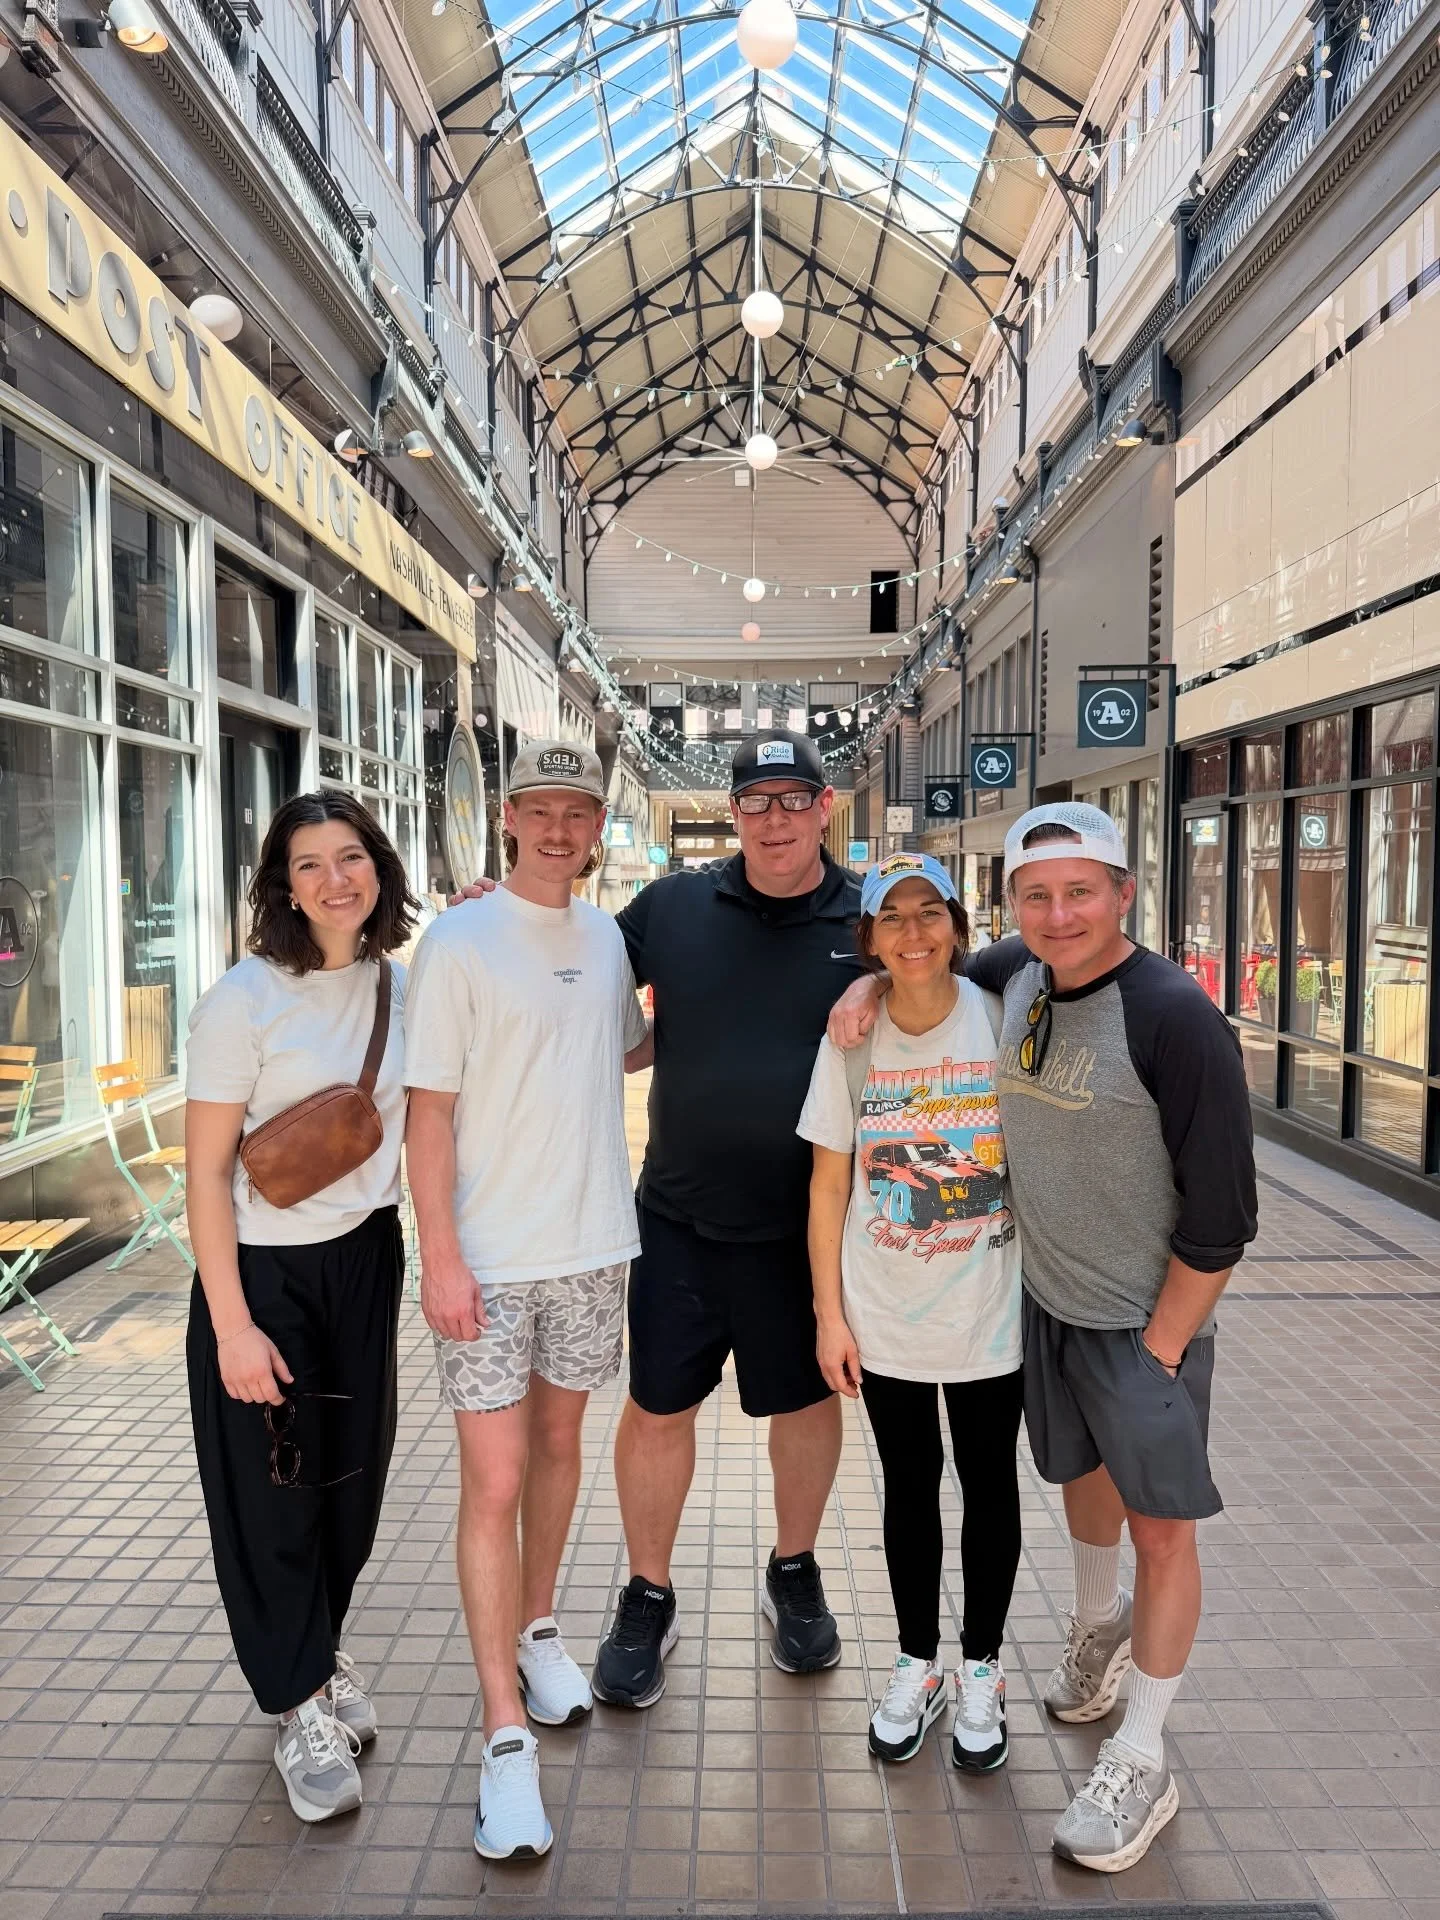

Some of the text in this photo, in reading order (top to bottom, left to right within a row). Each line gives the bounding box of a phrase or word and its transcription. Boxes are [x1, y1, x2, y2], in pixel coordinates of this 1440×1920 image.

[47, 186, 361, 555] POST OFFICE
[438, 586, 473, 638] TENNESSEE
[1093, 701, 1131, 725] 19 A 02
[543, 753, 578, 767] TED'S
[983, 757, 1002, 774] A
[0, 907, 32, 952] A 02
[866, 1216, 914, 1251] Fast
[911, 1222, 982, 1264] Speed
